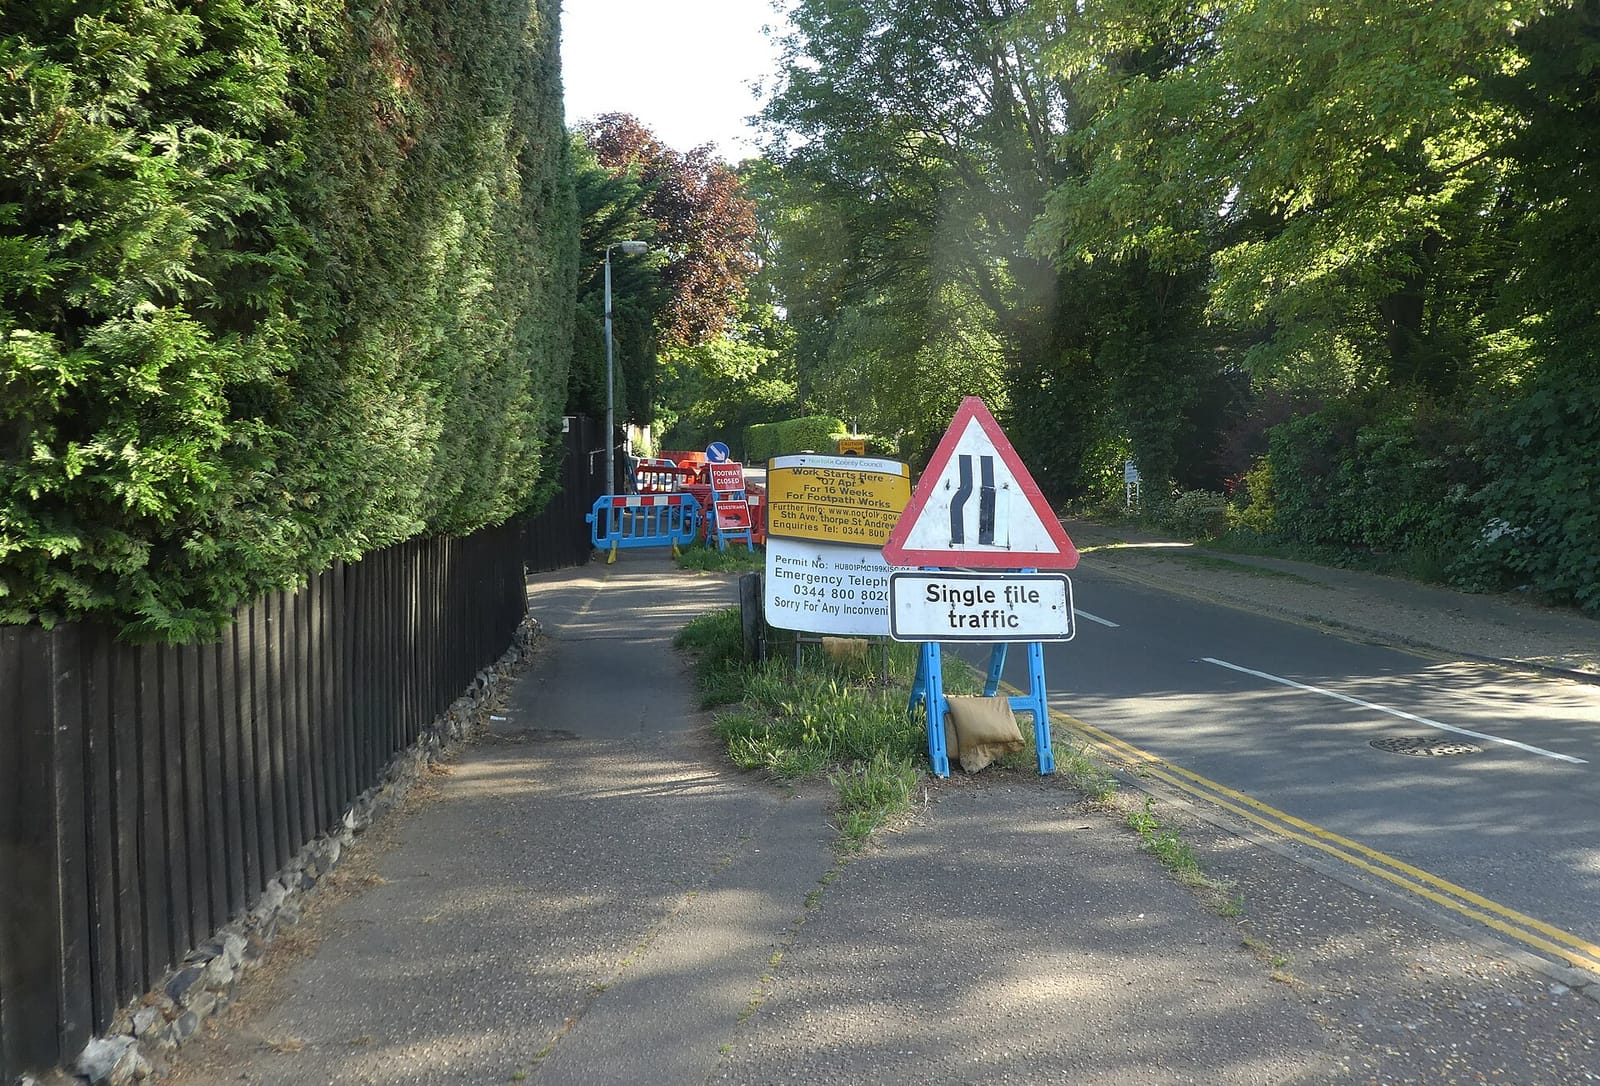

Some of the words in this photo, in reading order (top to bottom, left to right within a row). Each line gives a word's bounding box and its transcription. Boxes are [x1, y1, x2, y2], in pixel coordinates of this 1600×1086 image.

[792, 468, 819, 476] Work
[823, 469, 856, 480] Starts
[859, 473, 884, 482] Here
[821, 477, 834, 486] 07
[838, 478, 856, 487] Apr
[804, 484, 820, 492] For
[825, 486, 836, 494] 16
[840, 487, 874, 497] Weeks
[773, 503, 803, 511] Further
[807, 504, 825, 513] info:
[786, 492, 803, 500] For
[807, 493, 855, 504] Footpath
[858, 498, 891, 508] Works
[799, 513, 817, 522] Ave,
[820, 514, 849, 525] thorpe
[853, 518, 862, 526] St
[773, 520, 819, 531] Enquiries
[823, 525, 838, 533] Tel:
[842, 527, 865, 536] 0344
[868, 528, 885, 537] 800
[775, 555, 807, 567] Permit
[812, 560, 828, 569] No:
[775, 567, 843, 586] Emergency
[848, 575, 888, 588] Teleph
[794, 584, 825, 597] 0344
[831, 588, 855, 600] 800
[926, 583, 996, 606] Single
[1004, 586, 1040, 603] file
[774, 596, 800, 611] Sorry
[803, 601, 818, 612] For
[821, 602, 840, 616] Any
[948, 610, 1019, 628] traffic
